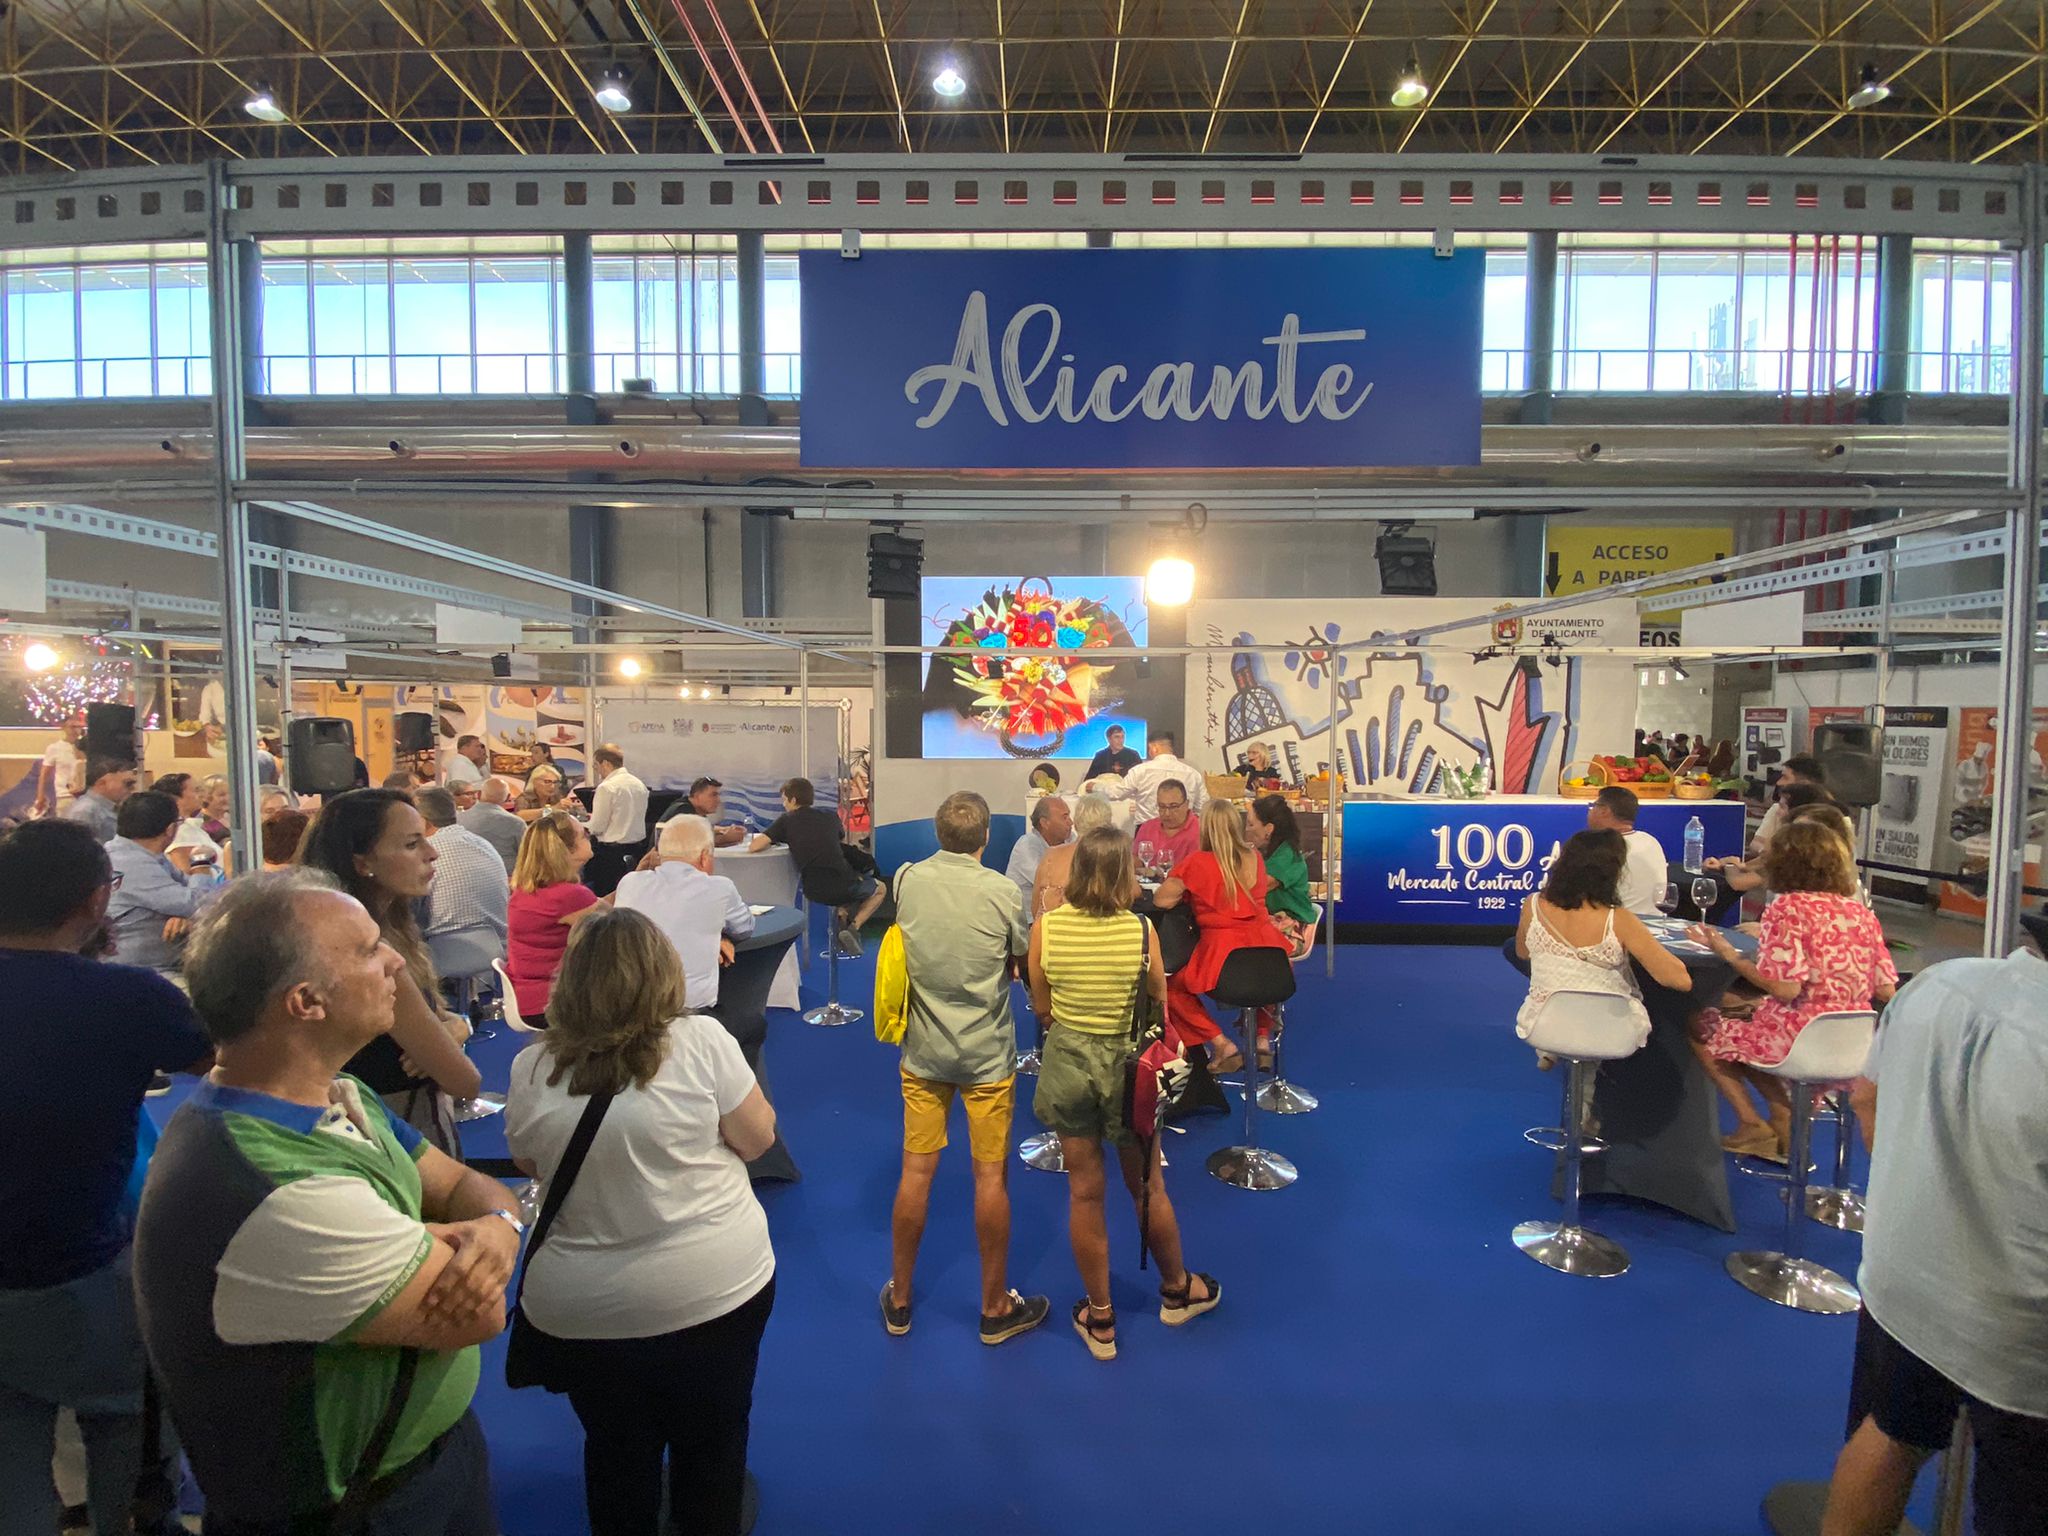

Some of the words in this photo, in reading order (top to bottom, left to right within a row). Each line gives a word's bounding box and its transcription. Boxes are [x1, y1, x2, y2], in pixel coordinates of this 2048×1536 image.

[904, 290, 1374, 428] Alicante
[1592, 545, 1669, 560] ACCESO
[1572, 570, 1585, 584] A
[1526, 618, 1605, 628] AYUNTAMIENTO
[1531, 630, 1545, 639] DE
[1547, 630, 1598, 639] ALICANTE
[1431, 824, 1534, 870] 100
[1388, 867, 1460, 893] Mercado
[1465, 869, 1534, 891] Central
[1477, 896, 1506, 910] 1922
